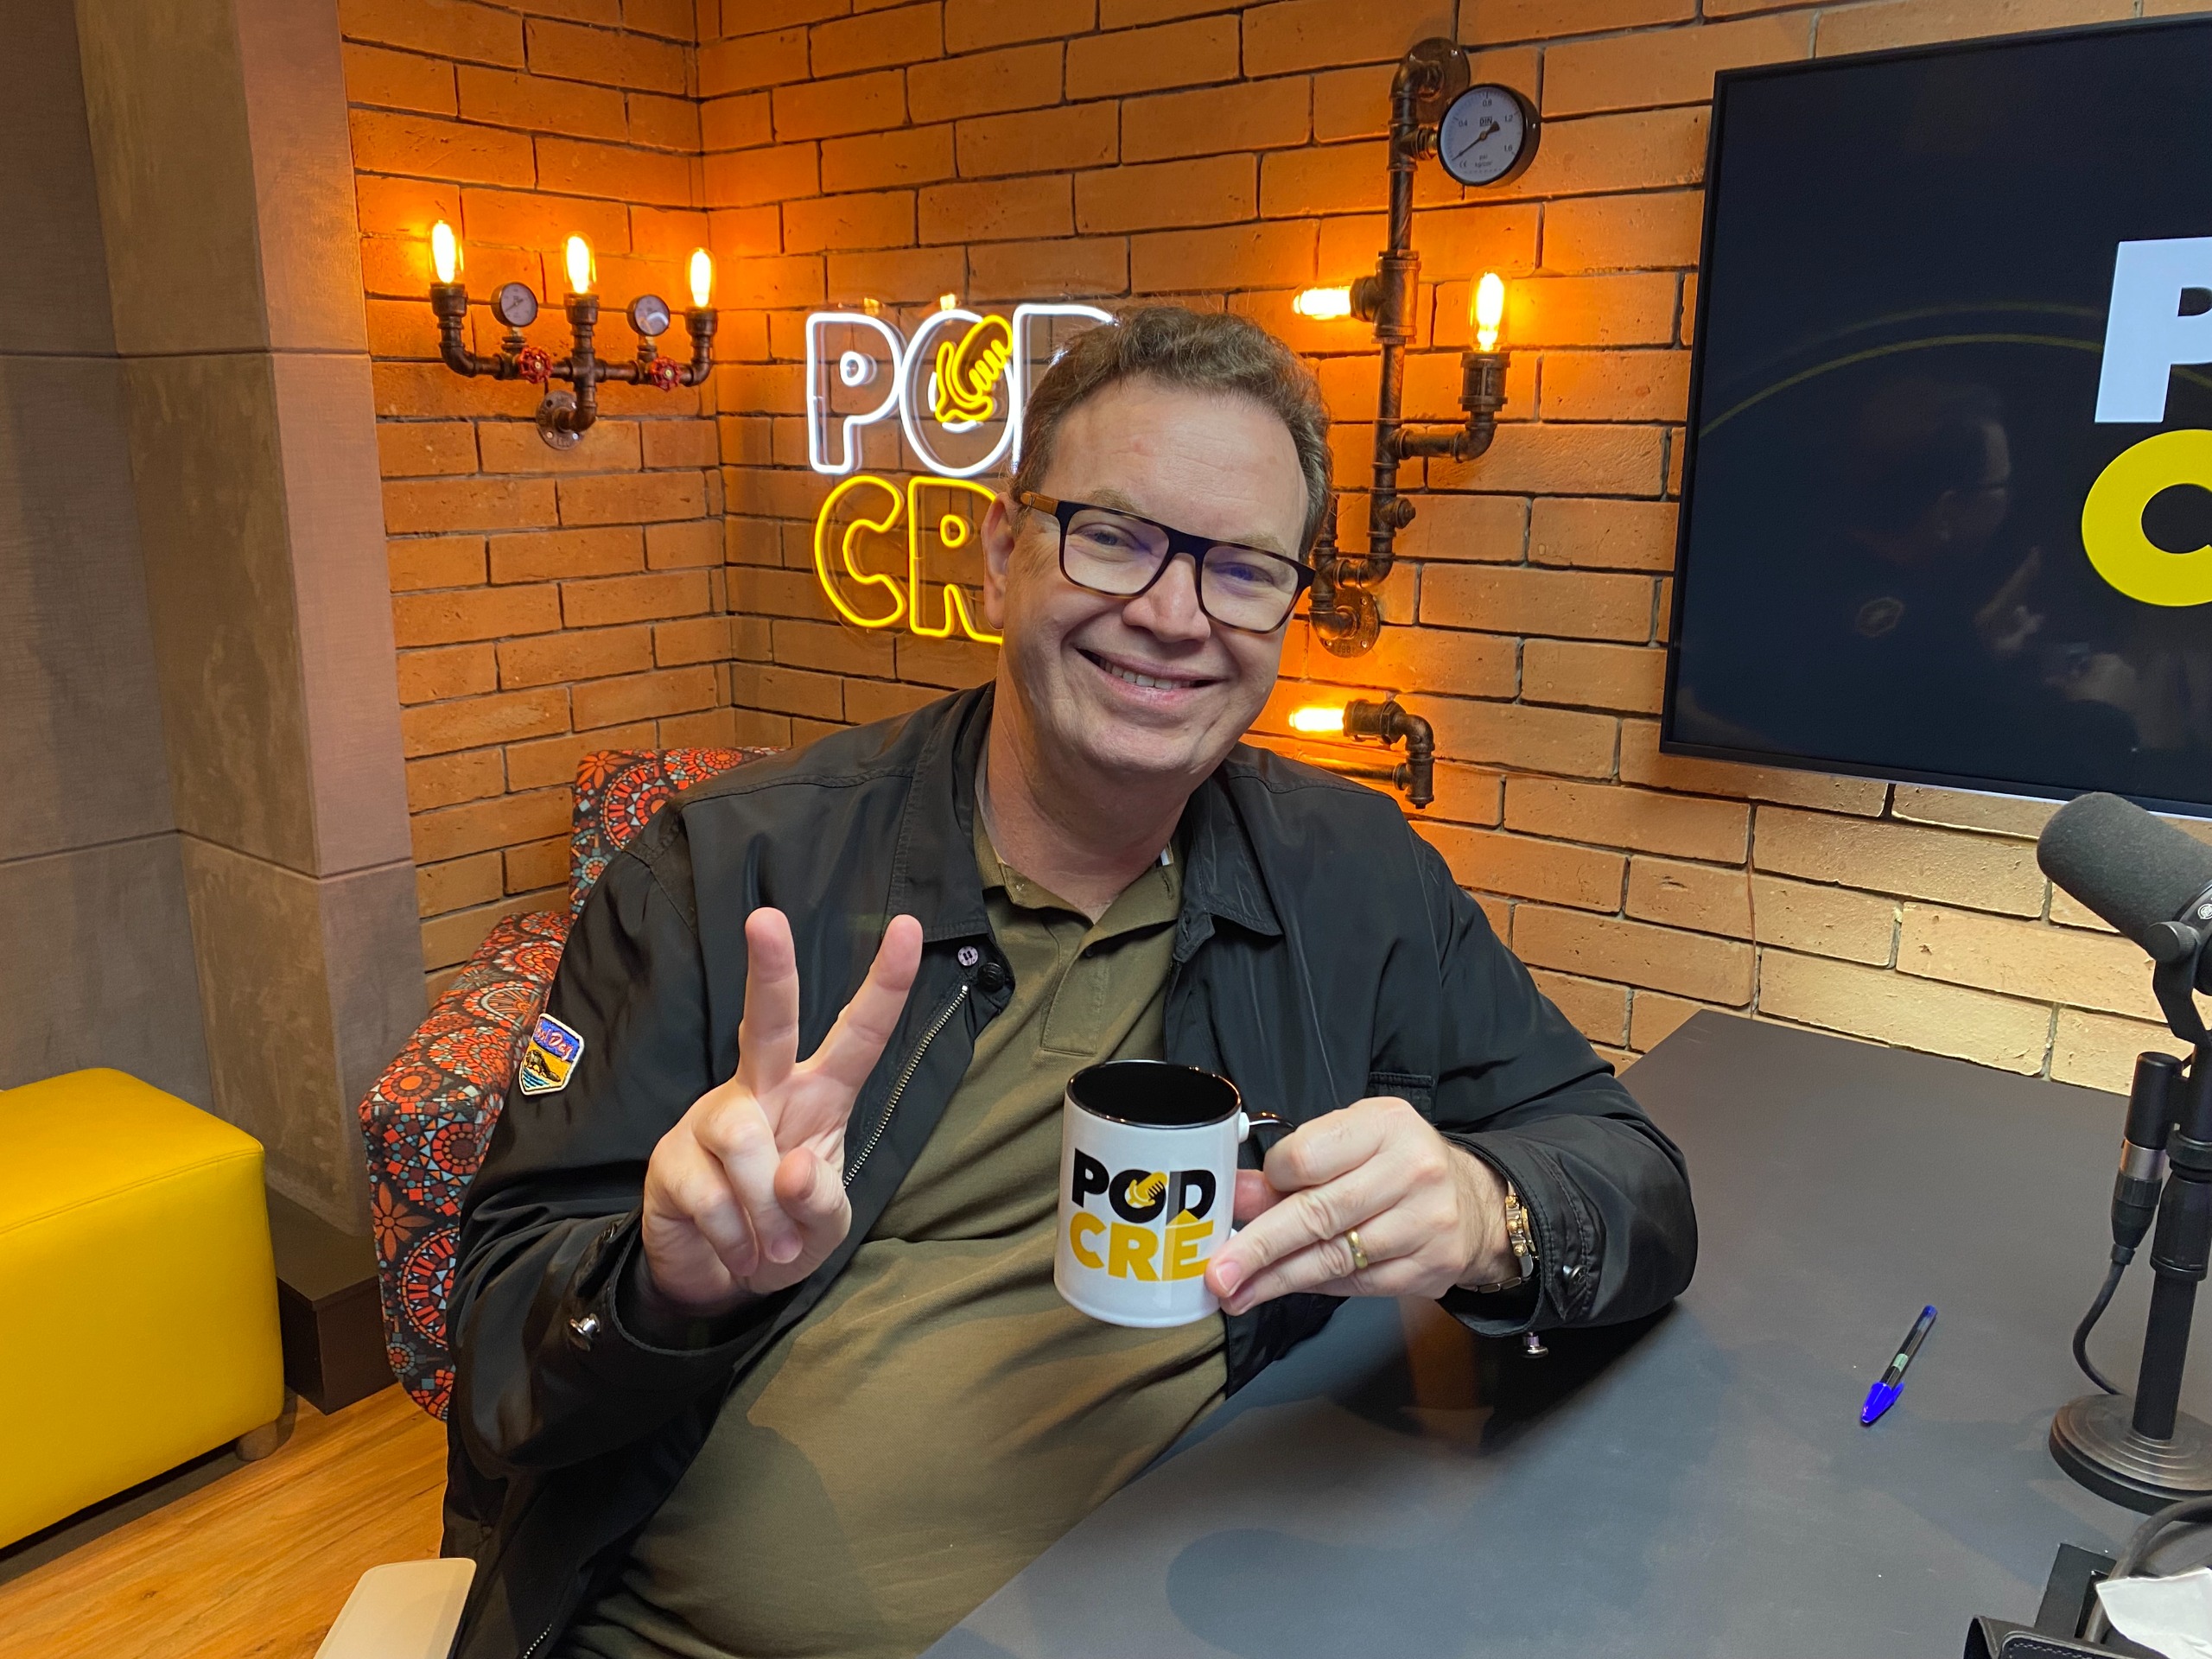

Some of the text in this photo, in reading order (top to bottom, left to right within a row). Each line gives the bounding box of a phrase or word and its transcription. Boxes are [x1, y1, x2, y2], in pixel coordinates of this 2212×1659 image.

[1479, 117, 1492, 125] DIN
[814, 475, 1003, 645] CR
[1071, 1147, 1217, 1226] POD
